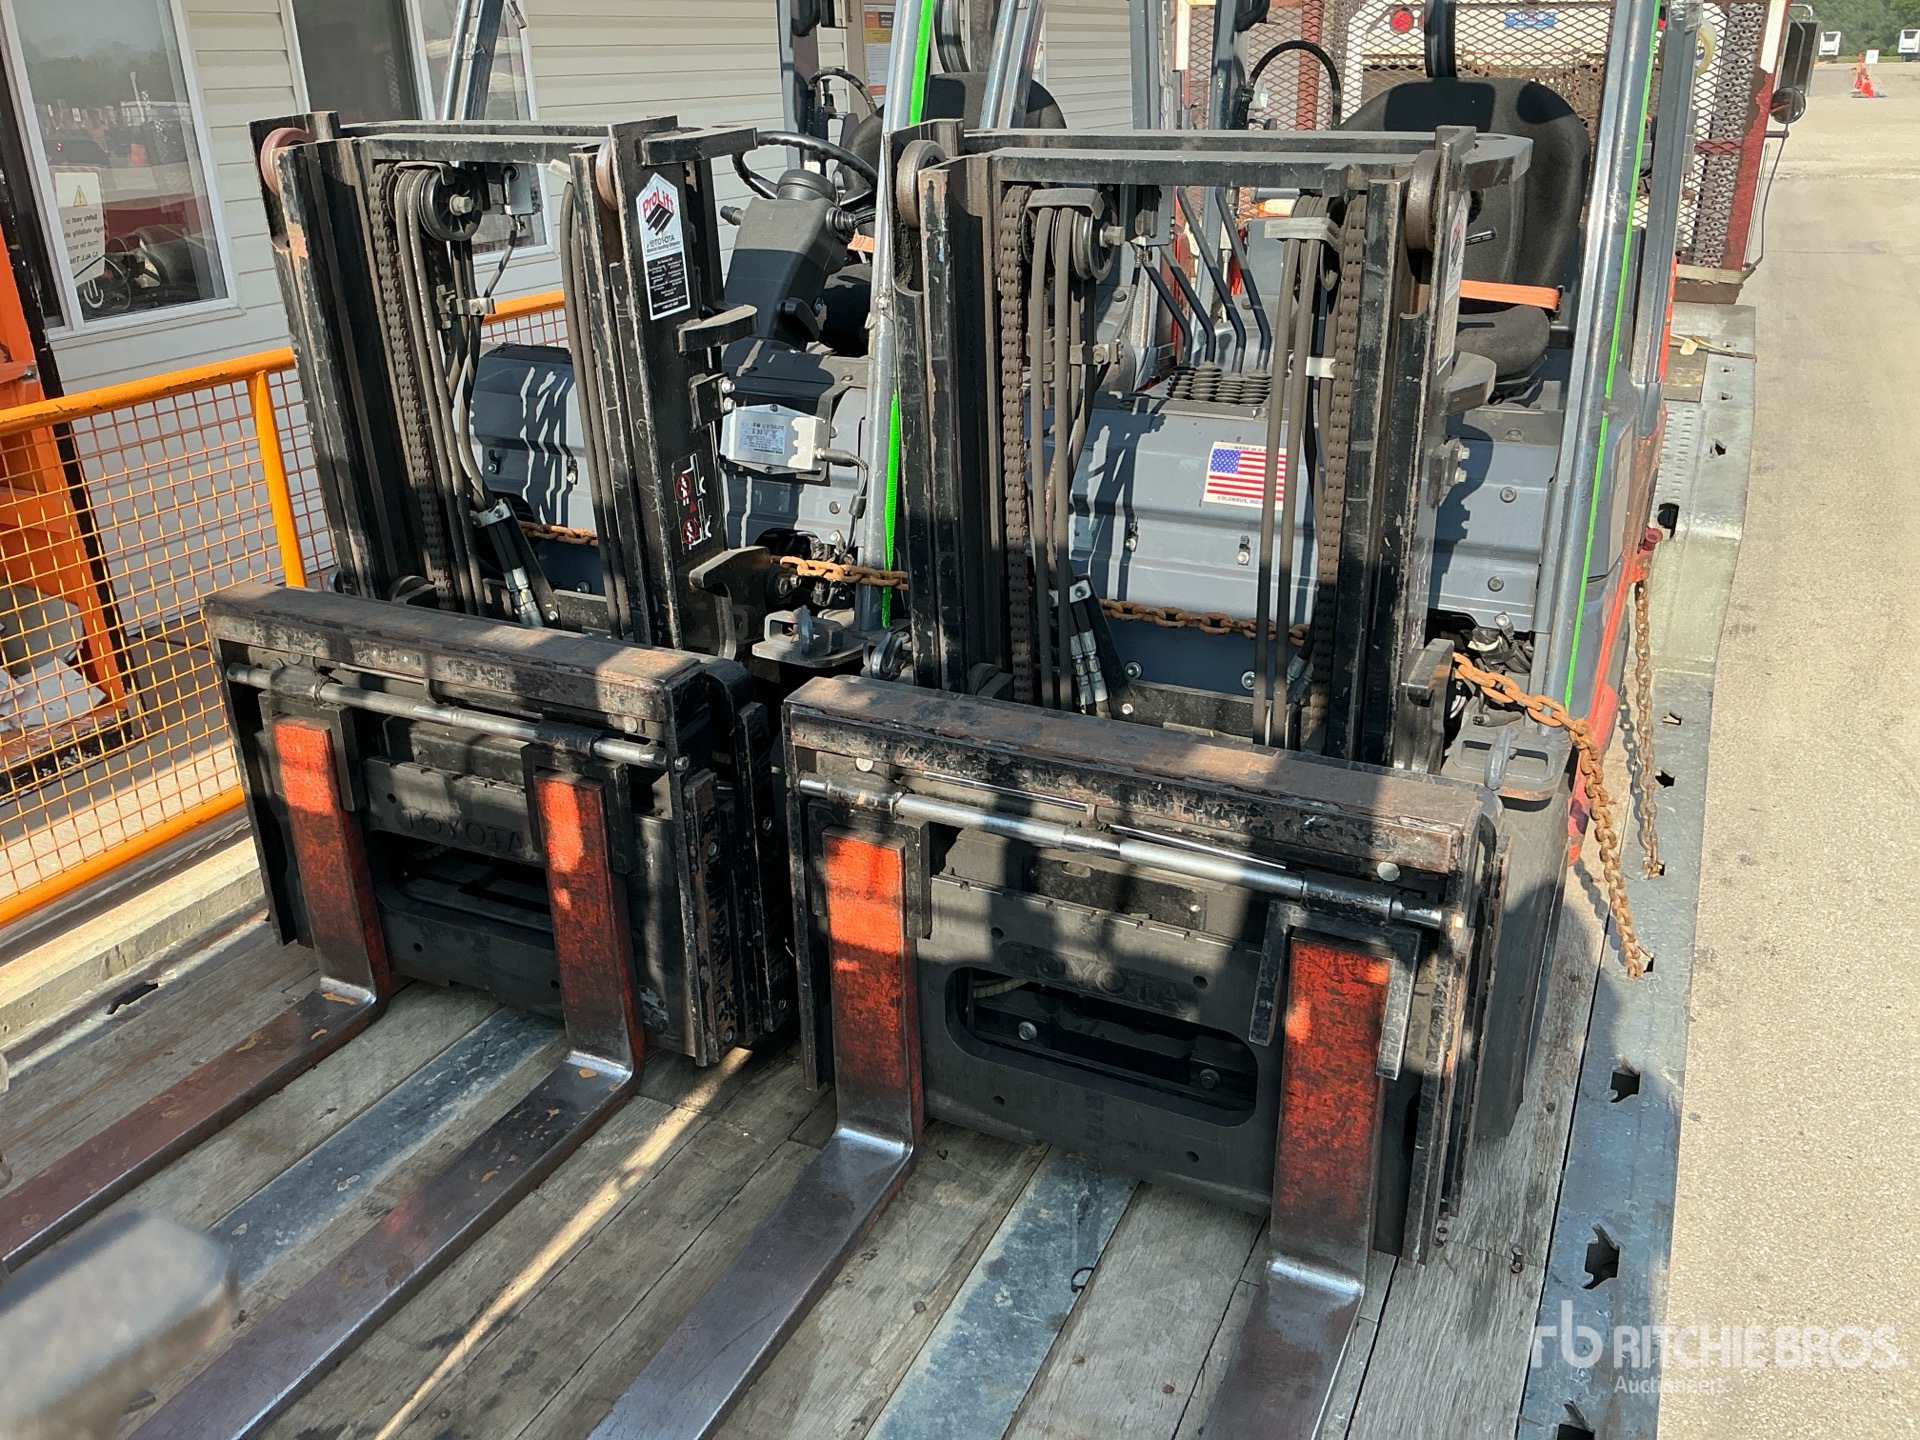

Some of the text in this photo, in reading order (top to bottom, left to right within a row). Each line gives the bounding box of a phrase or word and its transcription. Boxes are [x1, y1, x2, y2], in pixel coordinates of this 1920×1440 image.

[643, 186, 674, 220] ProLift
[654, 234, 675, 246] TOYOTA
[1217, 496, 1249, 504] COLUMBUS,
[406, 810, 524, 852] TOYOTA
[1006, 943, 1184, 1009] TOYOTA
